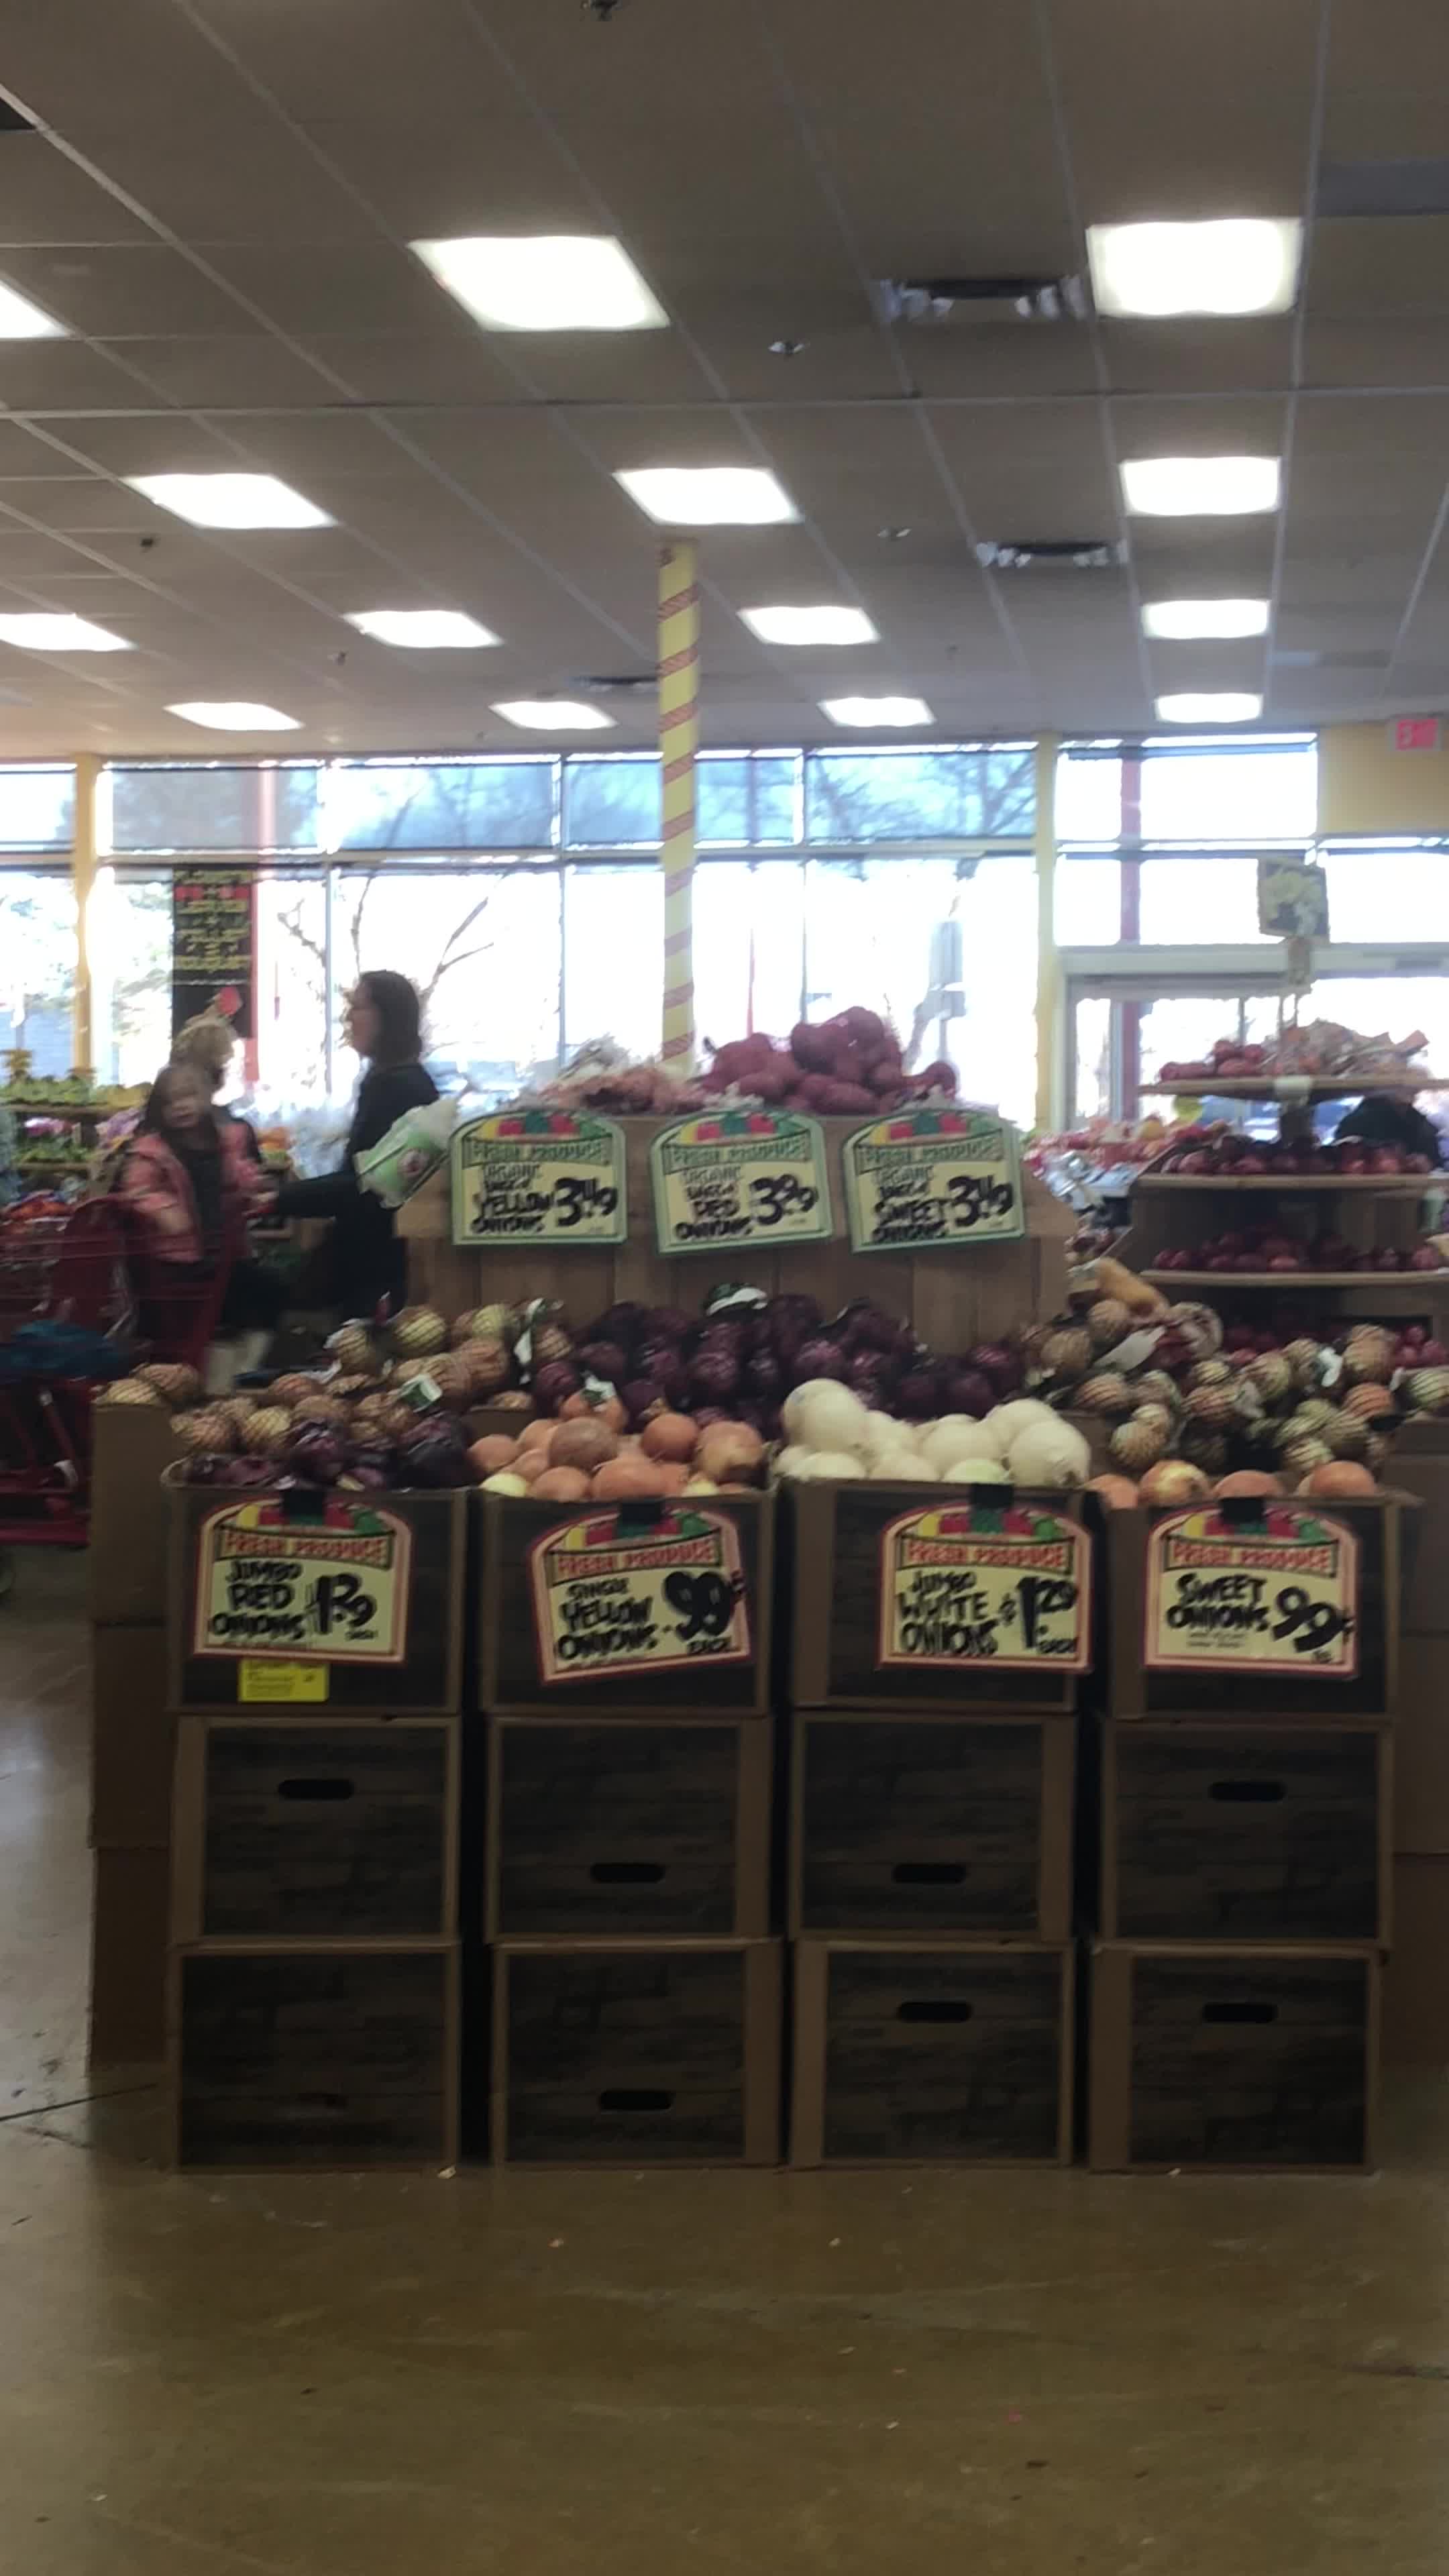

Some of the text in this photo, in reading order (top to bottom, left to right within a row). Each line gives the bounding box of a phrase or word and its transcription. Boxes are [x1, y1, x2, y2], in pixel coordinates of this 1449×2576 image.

[472, 1192, 555, 1218] YELLOW
[692, 1199, 741, 1223] RED
[874, 1197, 953, 1226] SWEET
[472, 1215, 545, 1234] ONIONS
[675, 1216, 754, 1240] ONIONS
[224, 1532, 388, 1566] FRESH PRODUCE
[557, 1539, 714, 1575] FRESH PRODUCE
[907, 1541, 1065, 1568] FRESH PRODUCE
[1173, 1542, 1331, 1571] FRESH PRODUCE
[225, 1561, 303, 1583] JUMBO
[910, 1570, 977, 1593] JUMBO
[227, 1582, 295, 1611] RED
[566, 1577, 629, 1600] SINGLE
[1177, 1572, 1268, 1609] SWEET
[558, 1595, 653, 1632] YELLOW
[896, 1590, 990, 1622] WHITE
[1166, 1603, 1271, 1632] ONIONS
[208, 1612, 306, 1641] ONIONS
[900, 1616, 1000, 1658] ONIONS
[556, 1623, 659, 1661] ONIONS
